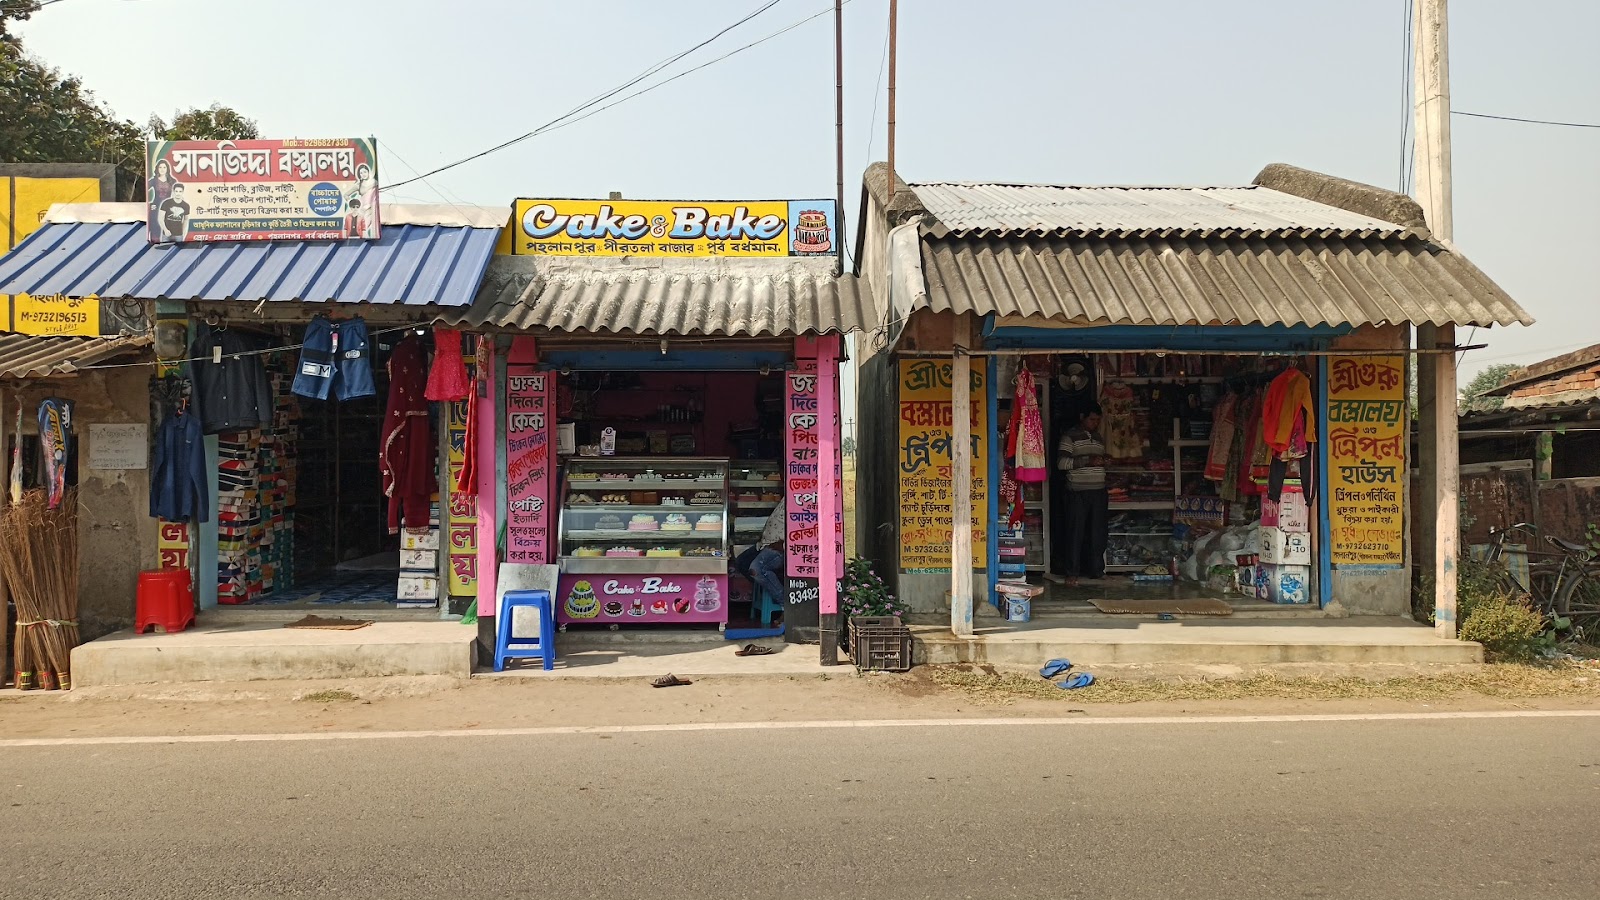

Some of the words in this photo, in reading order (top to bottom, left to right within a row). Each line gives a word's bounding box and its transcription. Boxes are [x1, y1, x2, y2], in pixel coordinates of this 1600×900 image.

[172, 140, 271, 178] সানজিদা
[278, 148, 355, 178] বস্ত্রালয়
[522, 203, 650, 240] Cake
[650, 214, 669, 238] &
[668, 206, 787, 240] Bake
[604, 240, 655, 253] পীরতলা
[658, 242, 694, 254] বাজার
[508, 374, 546, 392] জন্ম
[1328, 358, 1400, 394] শ্রীগুরু
[508, 393, 545, 410] দিনের
[508, 412, 546, 432] কেক
[1328, 399, 1404, 428] বস্ত্রালয়
[1330, 426, 1404, 460] ত্রিপল
[1338, 458, 1396, 484] হাউস
[510, 550, 526, 560] করা
[603, 580, 636, 595] Cake
[641, 577, 682, 594] Bake
